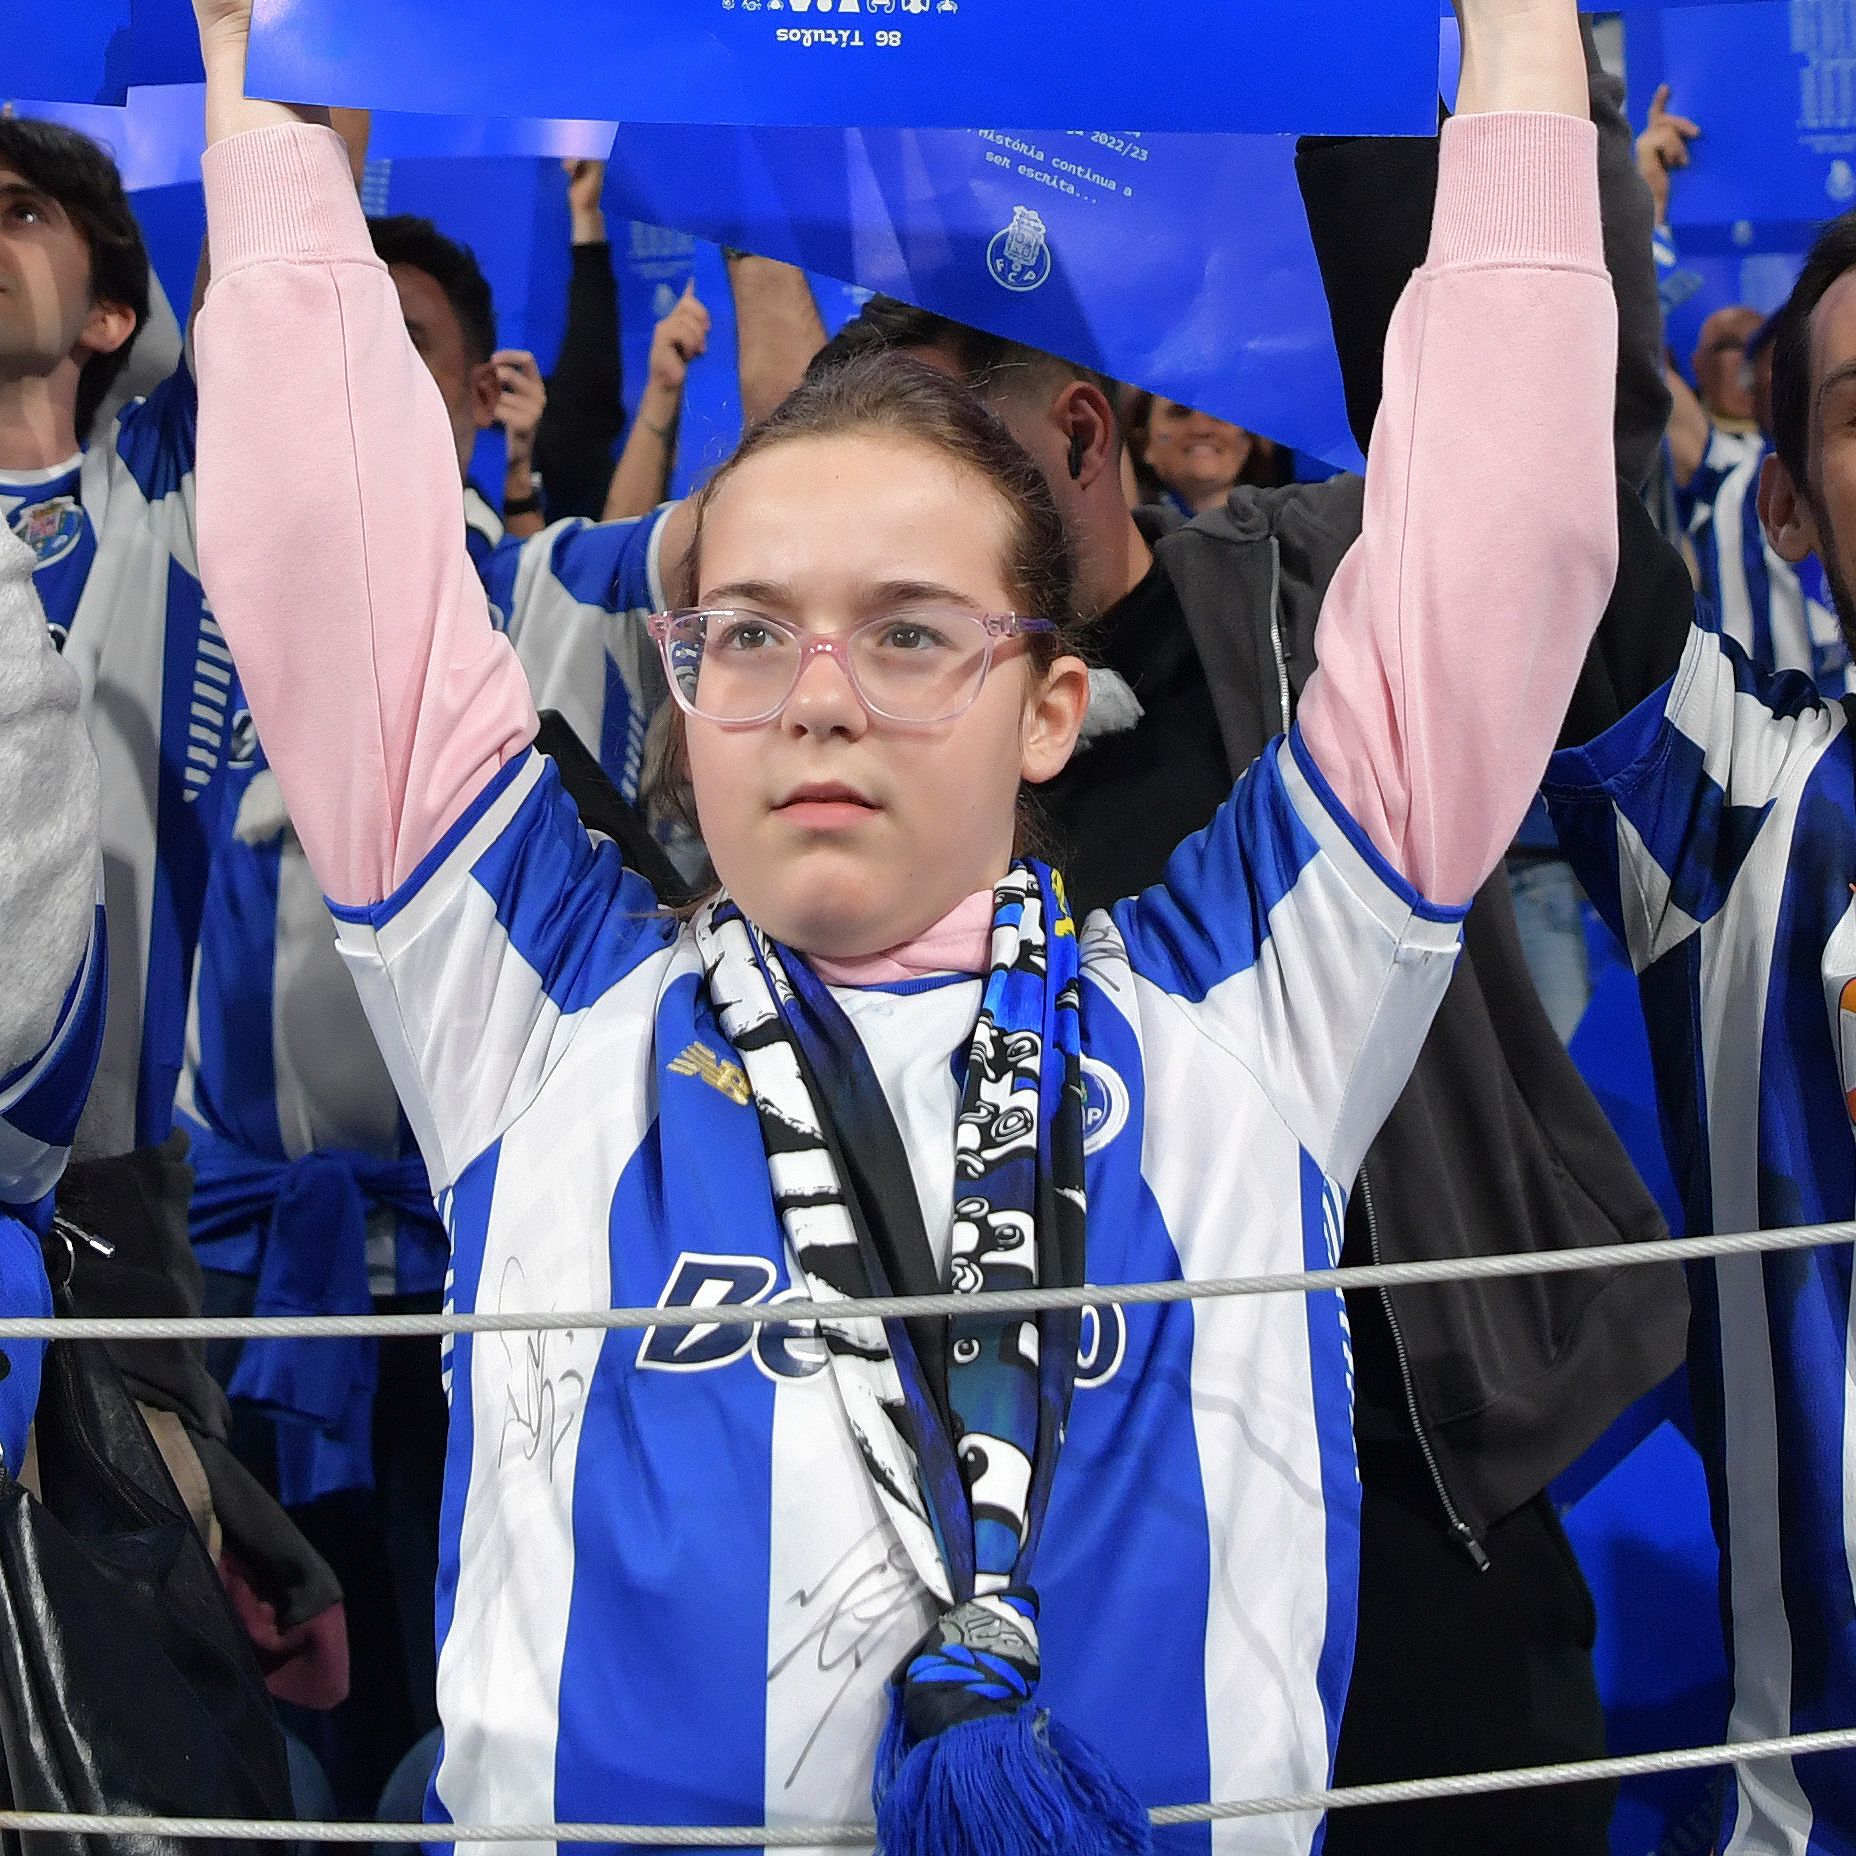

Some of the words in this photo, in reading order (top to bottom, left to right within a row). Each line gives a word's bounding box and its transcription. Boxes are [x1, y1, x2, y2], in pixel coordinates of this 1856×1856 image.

[775, 28, 865, 49] Títulos
[875, 30, 903, 48] 86
[1090, 130, 1149, 162] 2022/23
[984, 151, 1012, 170] ser
[1051, 156, 1117, 191] continua
[1122, 186, 1134, 198] a
